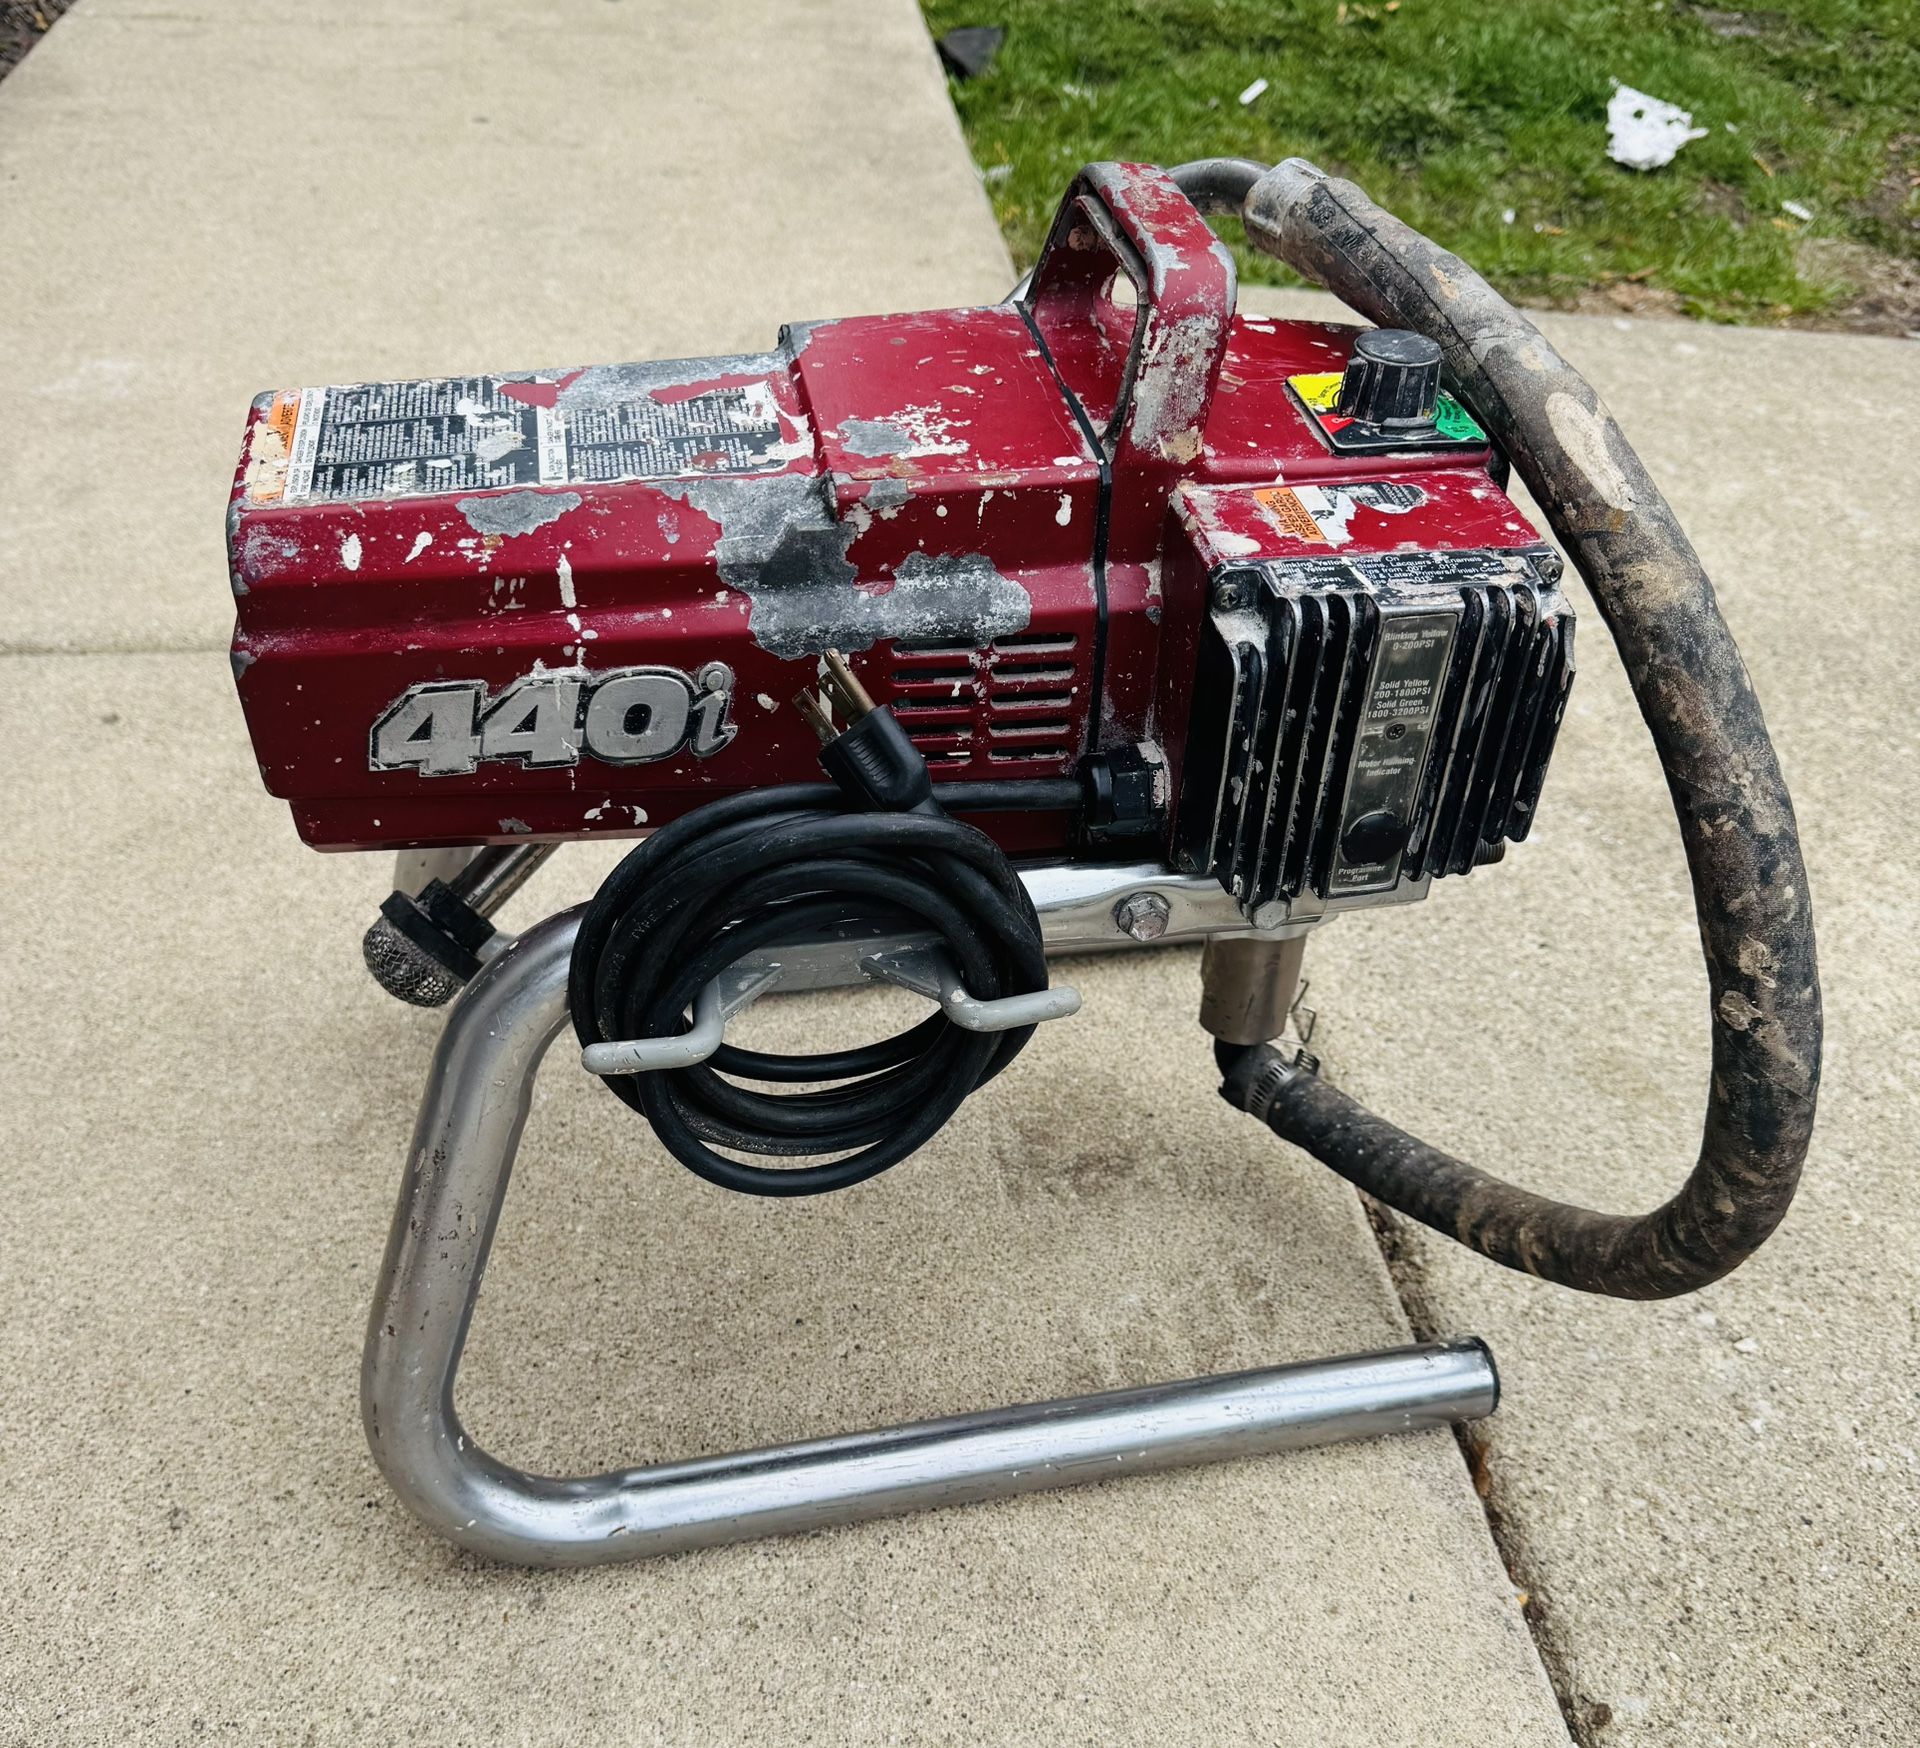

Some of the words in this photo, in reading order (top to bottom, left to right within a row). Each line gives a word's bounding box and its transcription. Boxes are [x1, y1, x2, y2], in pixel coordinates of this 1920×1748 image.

[1390, 559, 1433, 568] Lacquers
[1445, 556, 1482, 565] Enamels
[1381, 566, 1403, 574] from
[1384, 631, 1418, 641] Blinking
[1421, 629, 1449, 639] Yellow
[1392, 639, 1435, 651] 0-200PSI
[1380, 680, 1400, 690] Solid
[1404, 679, 1430, 688] Yellow
[1373, 686, 1431, 699] 200-1800PSI
[1376, 700, 1397, 710] Solid
[1399, 698, 1423, 708] Green
[1367, 705, 1430, 719] 1800-3200PSI
[369, 661, 738, 777] 440i
[1357, 759, 1381, 769] Motor
[1366, 766, 1402, 777] Indicator
